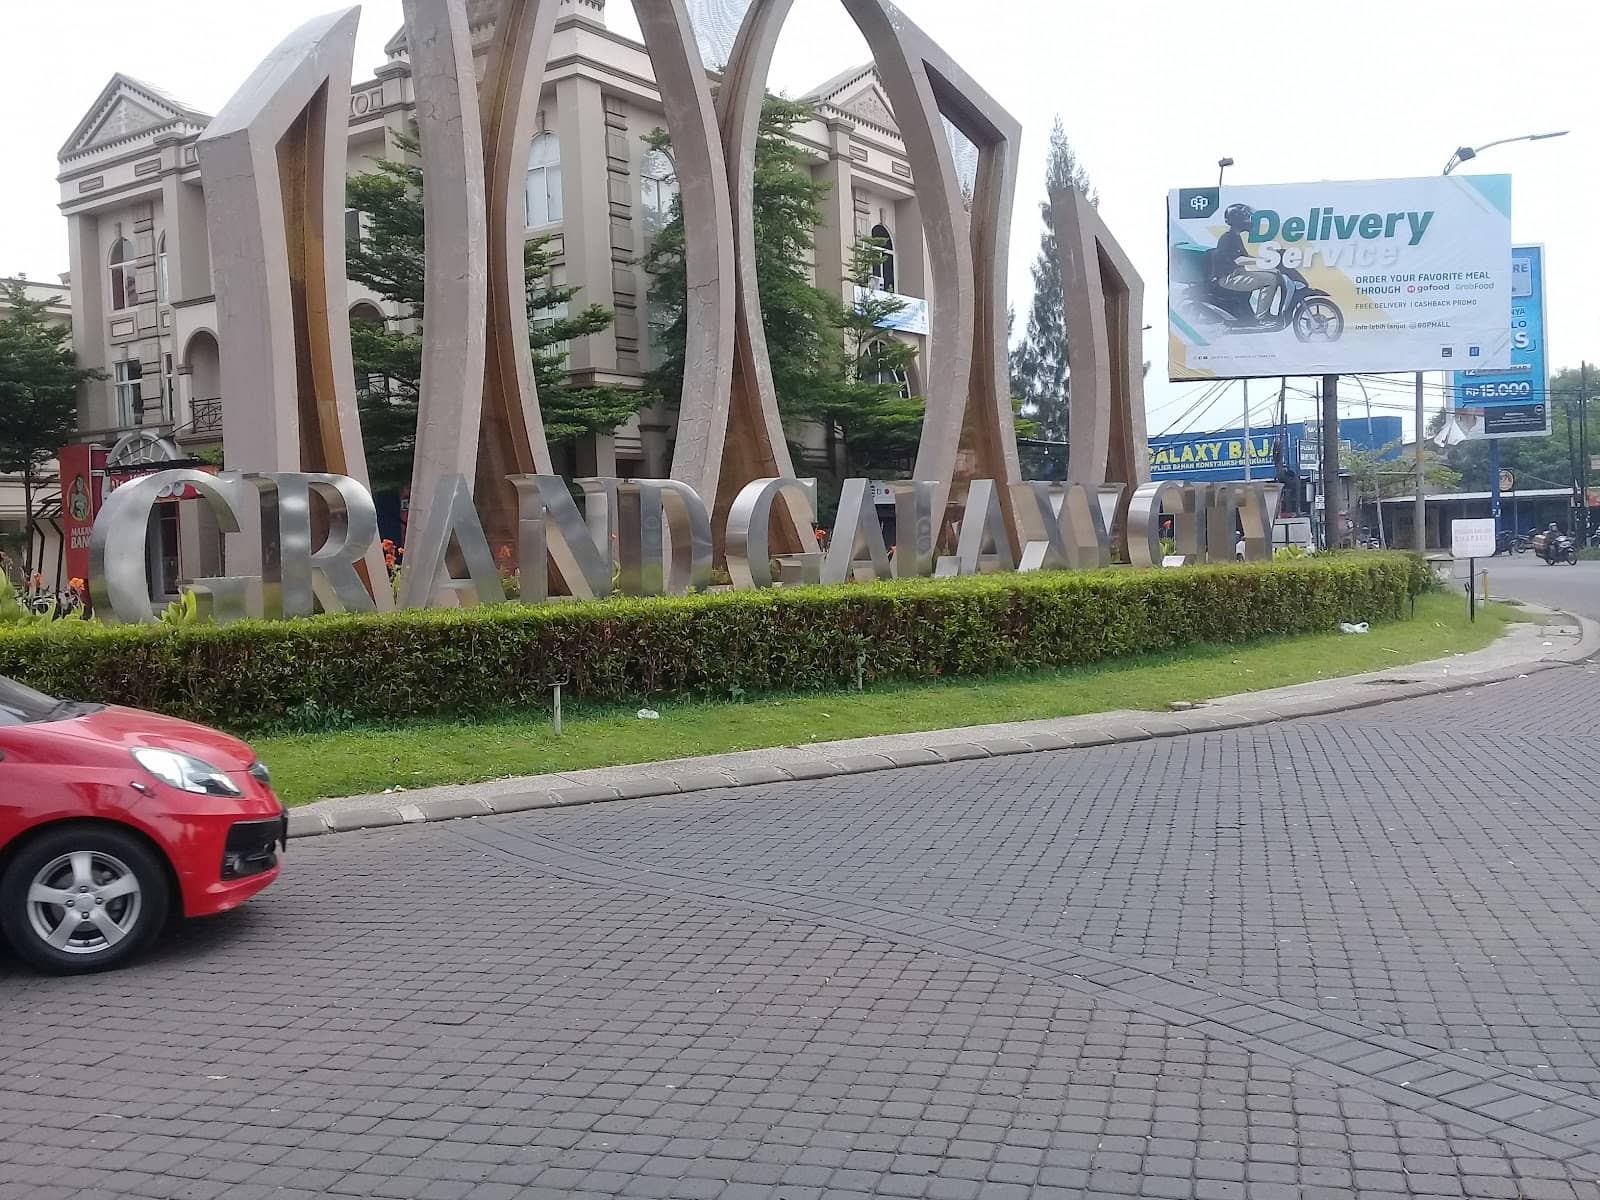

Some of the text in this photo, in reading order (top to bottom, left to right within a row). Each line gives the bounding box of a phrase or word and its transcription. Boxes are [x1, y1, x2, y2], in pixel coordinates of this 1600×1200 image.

[1248, 207, 1435, 246] Delivery
[1256, 241, 1399, 269] Service
[1355, 271, 1491, 284] ORDER YOUR FAVORITE MEAL
[1355, 285, 1401, 295] THROUGH
[1417, 283, 1450, 293] gofood
[1374, 302, 1407, 310] DELIVERY
[1414, 300, 1451, 308] CASHBACK
[1453, 299, 1477, 307] PROMO
[1228, 438, 1275, 459] BAJ
[1150, 463, 1172, 472] PPLIER
[71, 536, 91, 549] BAN
[88, 469, 1284, 622] GRAND GALAXY CITY
